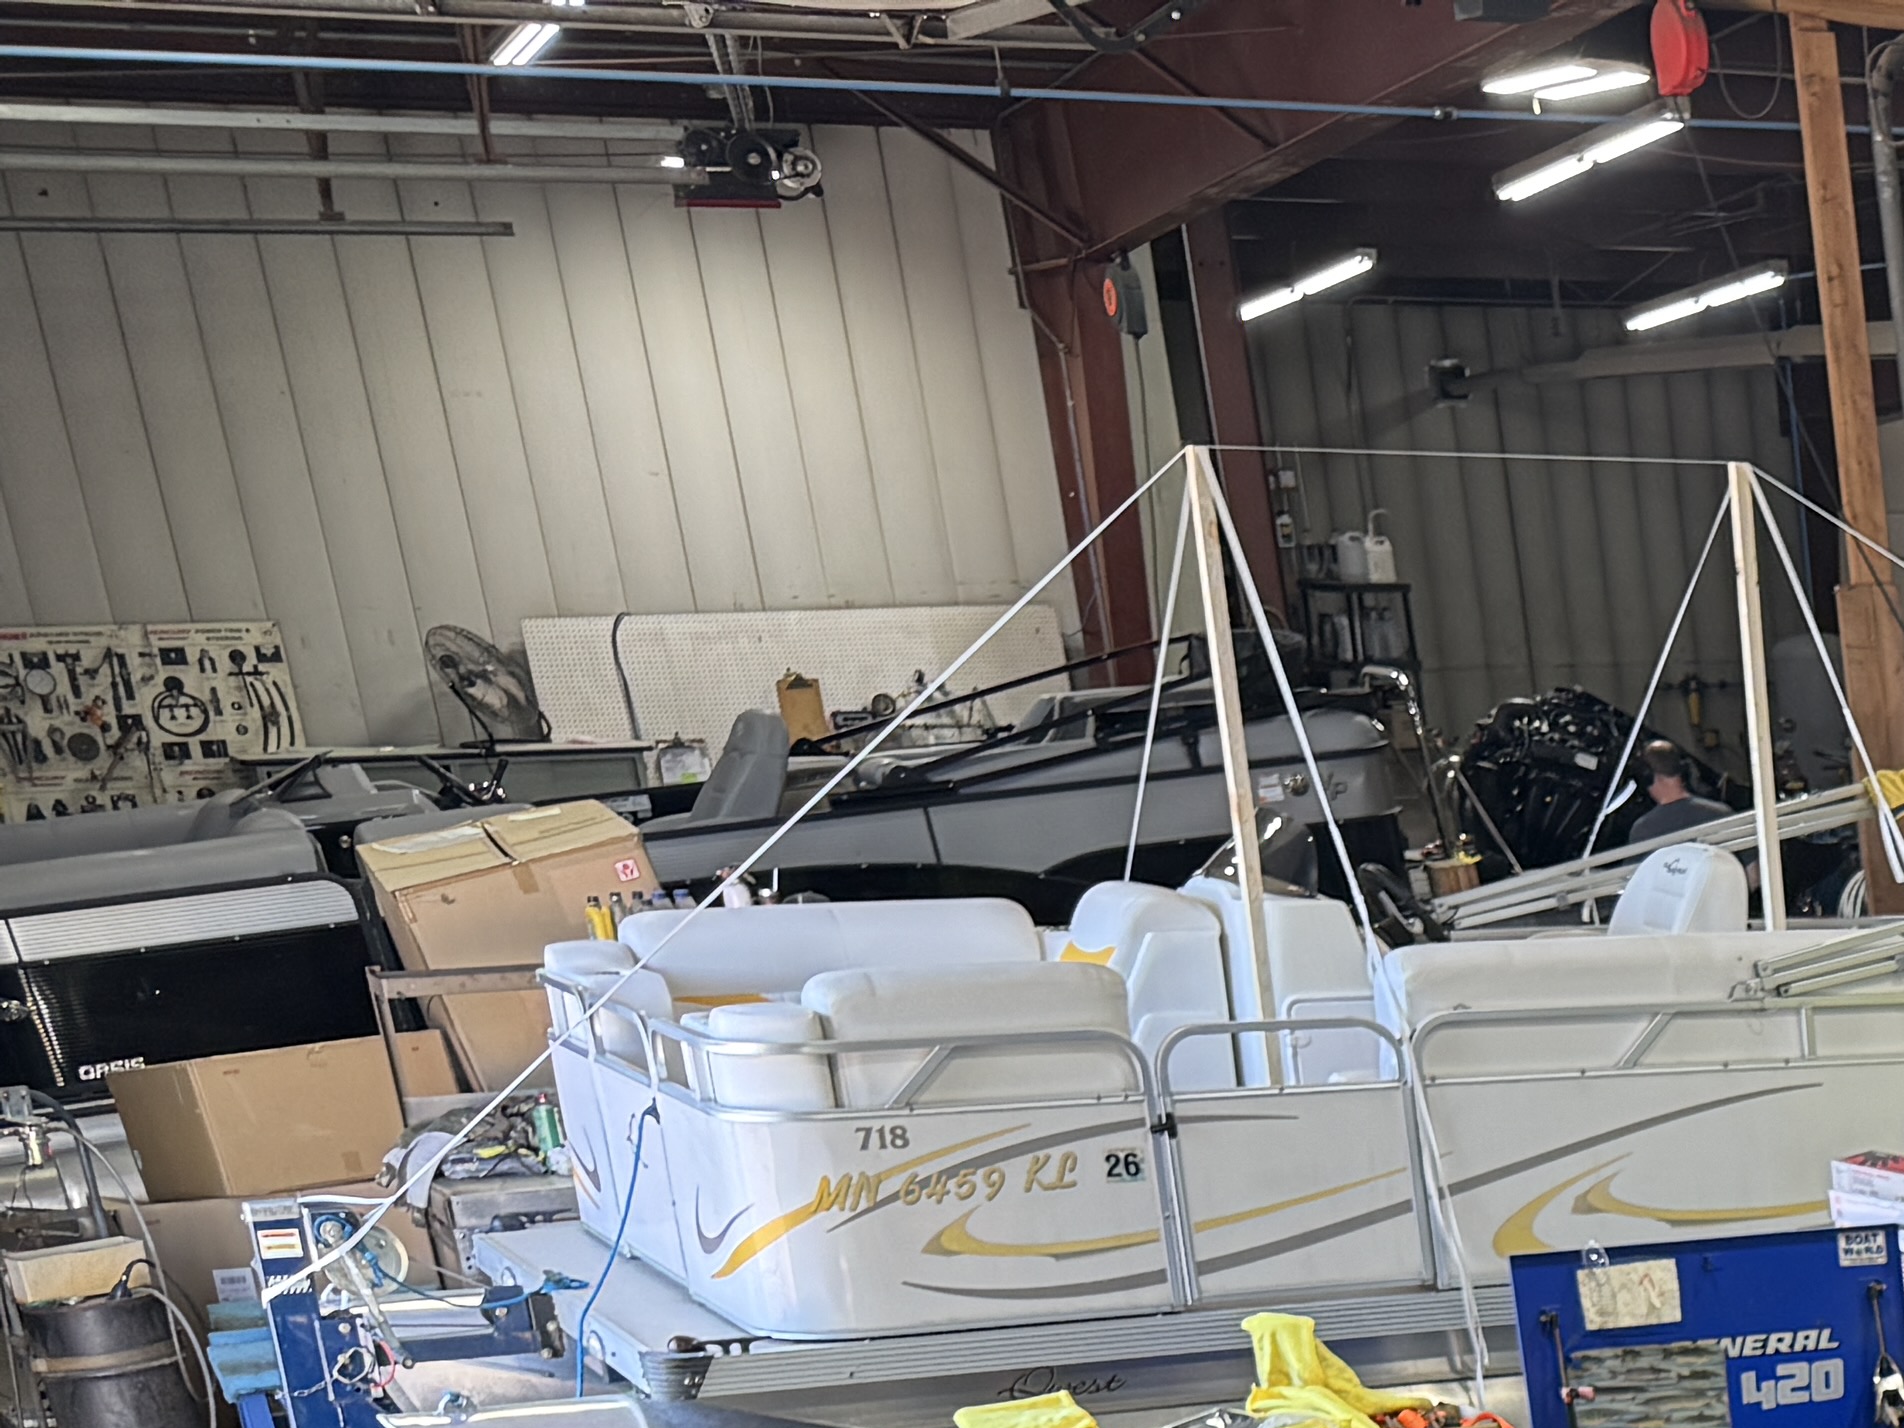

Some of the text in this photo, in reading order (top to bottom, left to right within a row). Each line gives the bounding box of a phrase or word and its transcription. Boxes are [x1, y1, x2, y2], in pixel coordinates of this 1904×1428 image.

[854, 1125, 910, 1151] 718
[1105, 1152, 1141, 1178] 26
[813, 1151, 1078, 1213] MN 6459 KL
[1844, 1232, 1880, 1246] BOAT
[1672, 1327, 1840, 1359] NERAL
[1740, 1358, 1845, 1411] 420
